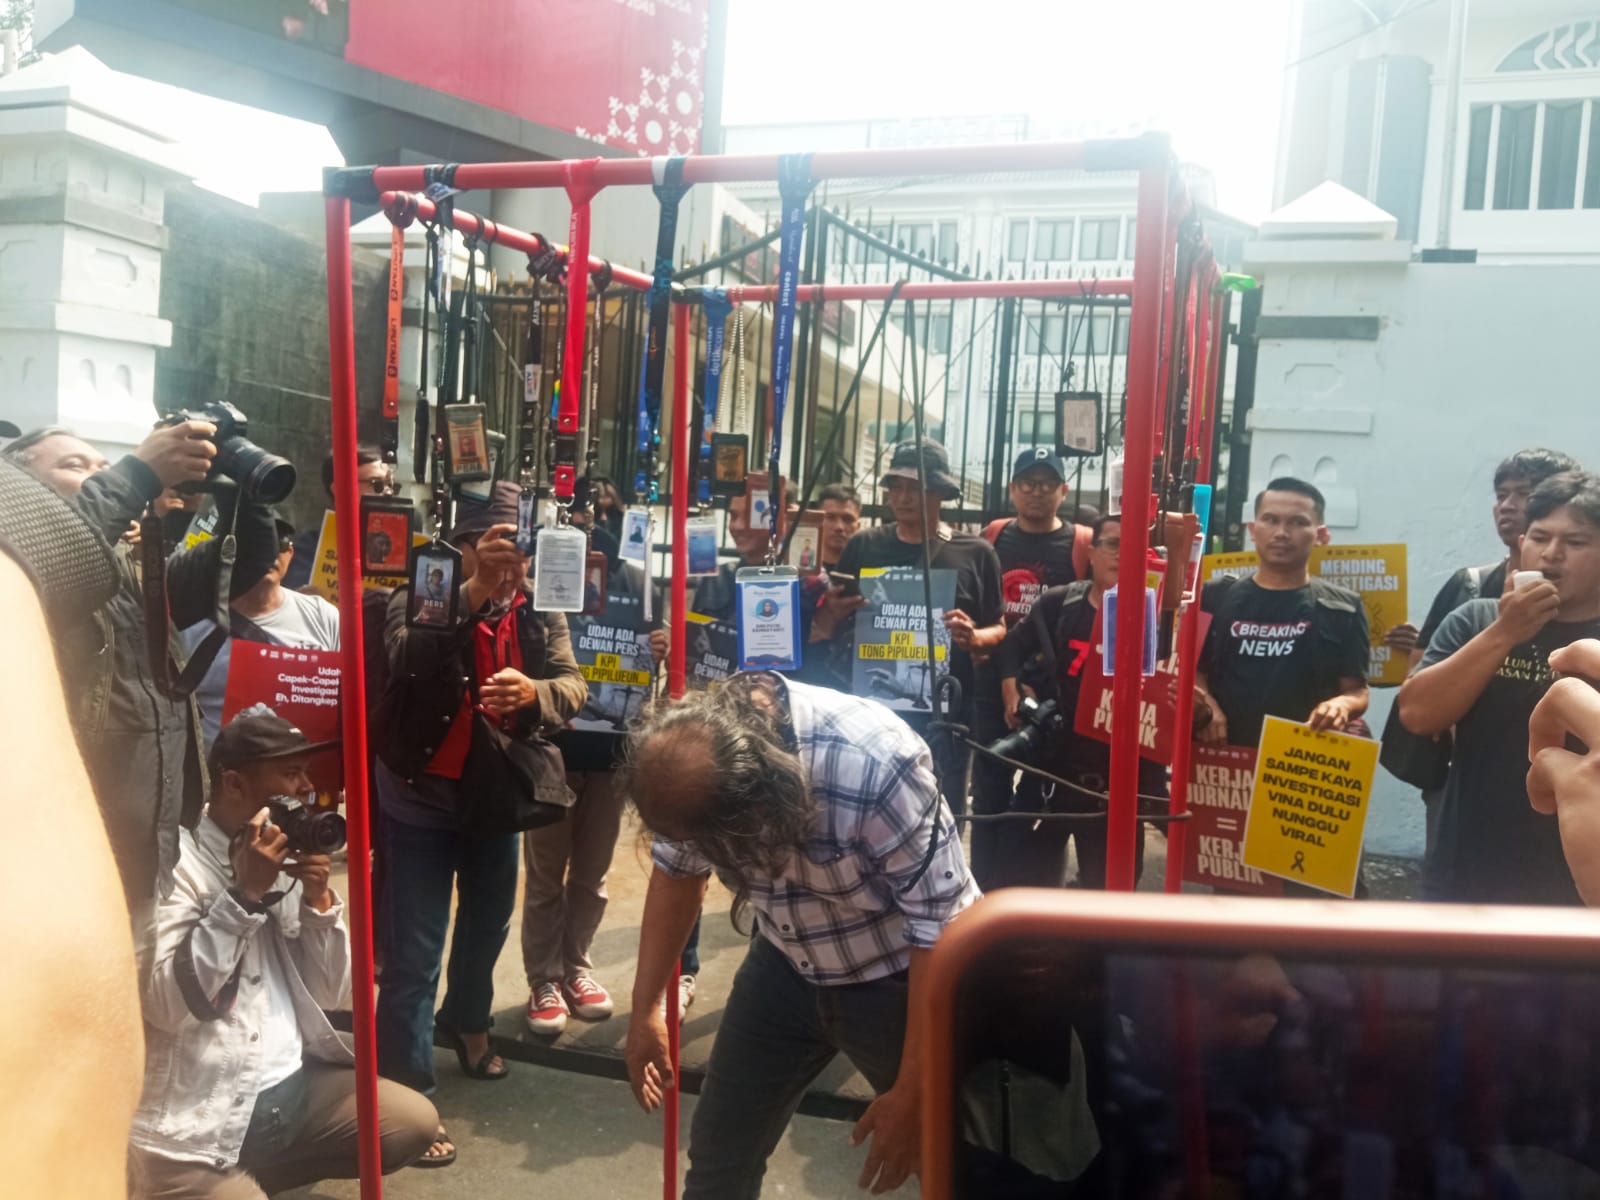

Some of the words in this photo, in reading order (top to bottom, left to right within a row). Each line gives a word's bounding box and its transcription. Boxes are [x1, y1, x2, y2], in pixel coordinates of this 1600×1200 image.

[1320, 559, 1386, 575] MENDING
[881, 603, 908, 617] UDAH
[908, 605, 927, 618] ADA
[1006, 601, 1032, 613] FREED
[873, 616, 908, 630] DEWAN
[908, 618, 928, 631] PER
[1240, 622, 1306, 639] BREAKING
[587, 624, 615, 640] UDAH
[615, 628, 635, 643] ADA
[894, 632, 910, 645] KPI
[579, 636, 614, 652] DEWAN
[615, 641, 640, 657] PERS
[861, 645, 886, 659] TONG
[1238, 640, 1295, 658] NEWS
[601, 655, 617, 668] KPI
[704, 652, 729, 670] UDAH
[275, 693, 289, 703] Eh,
[291, 684, 338, 697] Investigasi
[1284, 747, 1351, 771] JANGAN
[1196, 764, 1252, 791] KERJA
[1265, 757, 1319, 780] SAMPE
[1321, 772, 1363, 792] KAYA
[1187, 783, 1251, 811] JURNAL
[1262, 772, 1362, 808] INVESTIGASI
[1268, 789, 1305, 809] VINA
[1307, 801, 1351, 821] DULU
[1272, 807, 1340, 835] NUNGGU
[1280, 825, 1327, 848] VIRAL
[1199, 835, 1243, 861] KERJ
